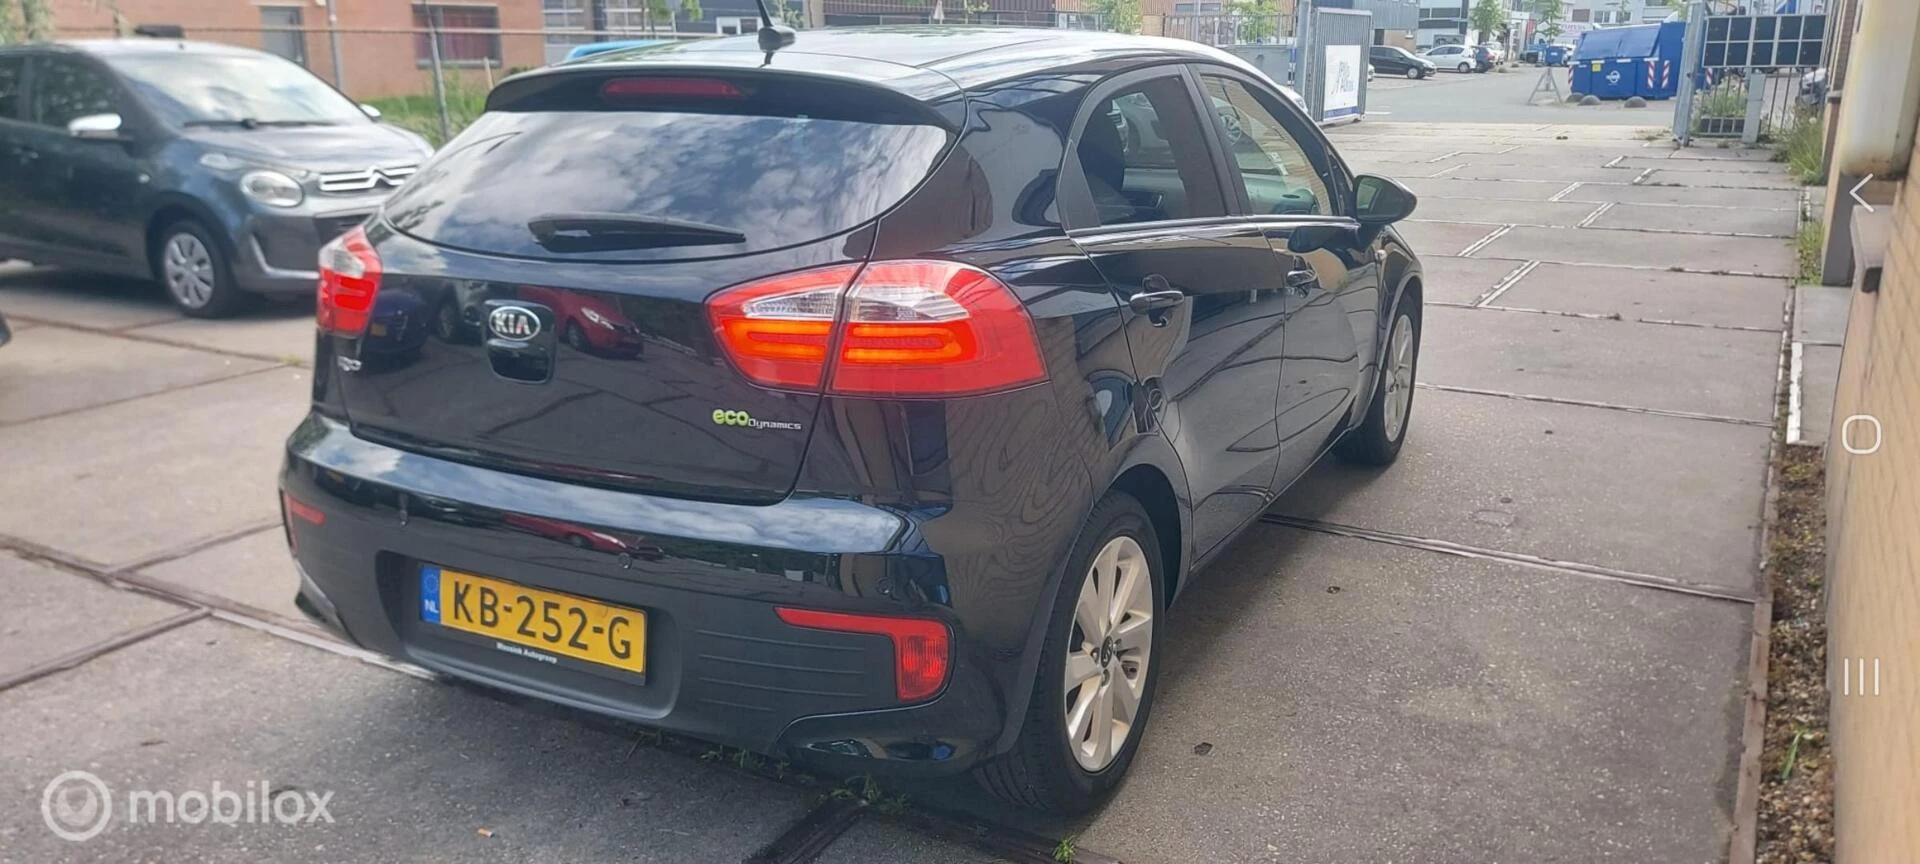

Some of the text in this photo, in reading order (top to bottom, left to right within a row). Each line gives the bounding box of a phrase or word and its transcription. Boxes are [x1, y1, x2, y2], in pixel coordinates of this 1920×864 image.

[494, 312, 531, 335] KIA
[424, 599, 439, 613] NL
[453, 580, 632, 660] KB-252-G
